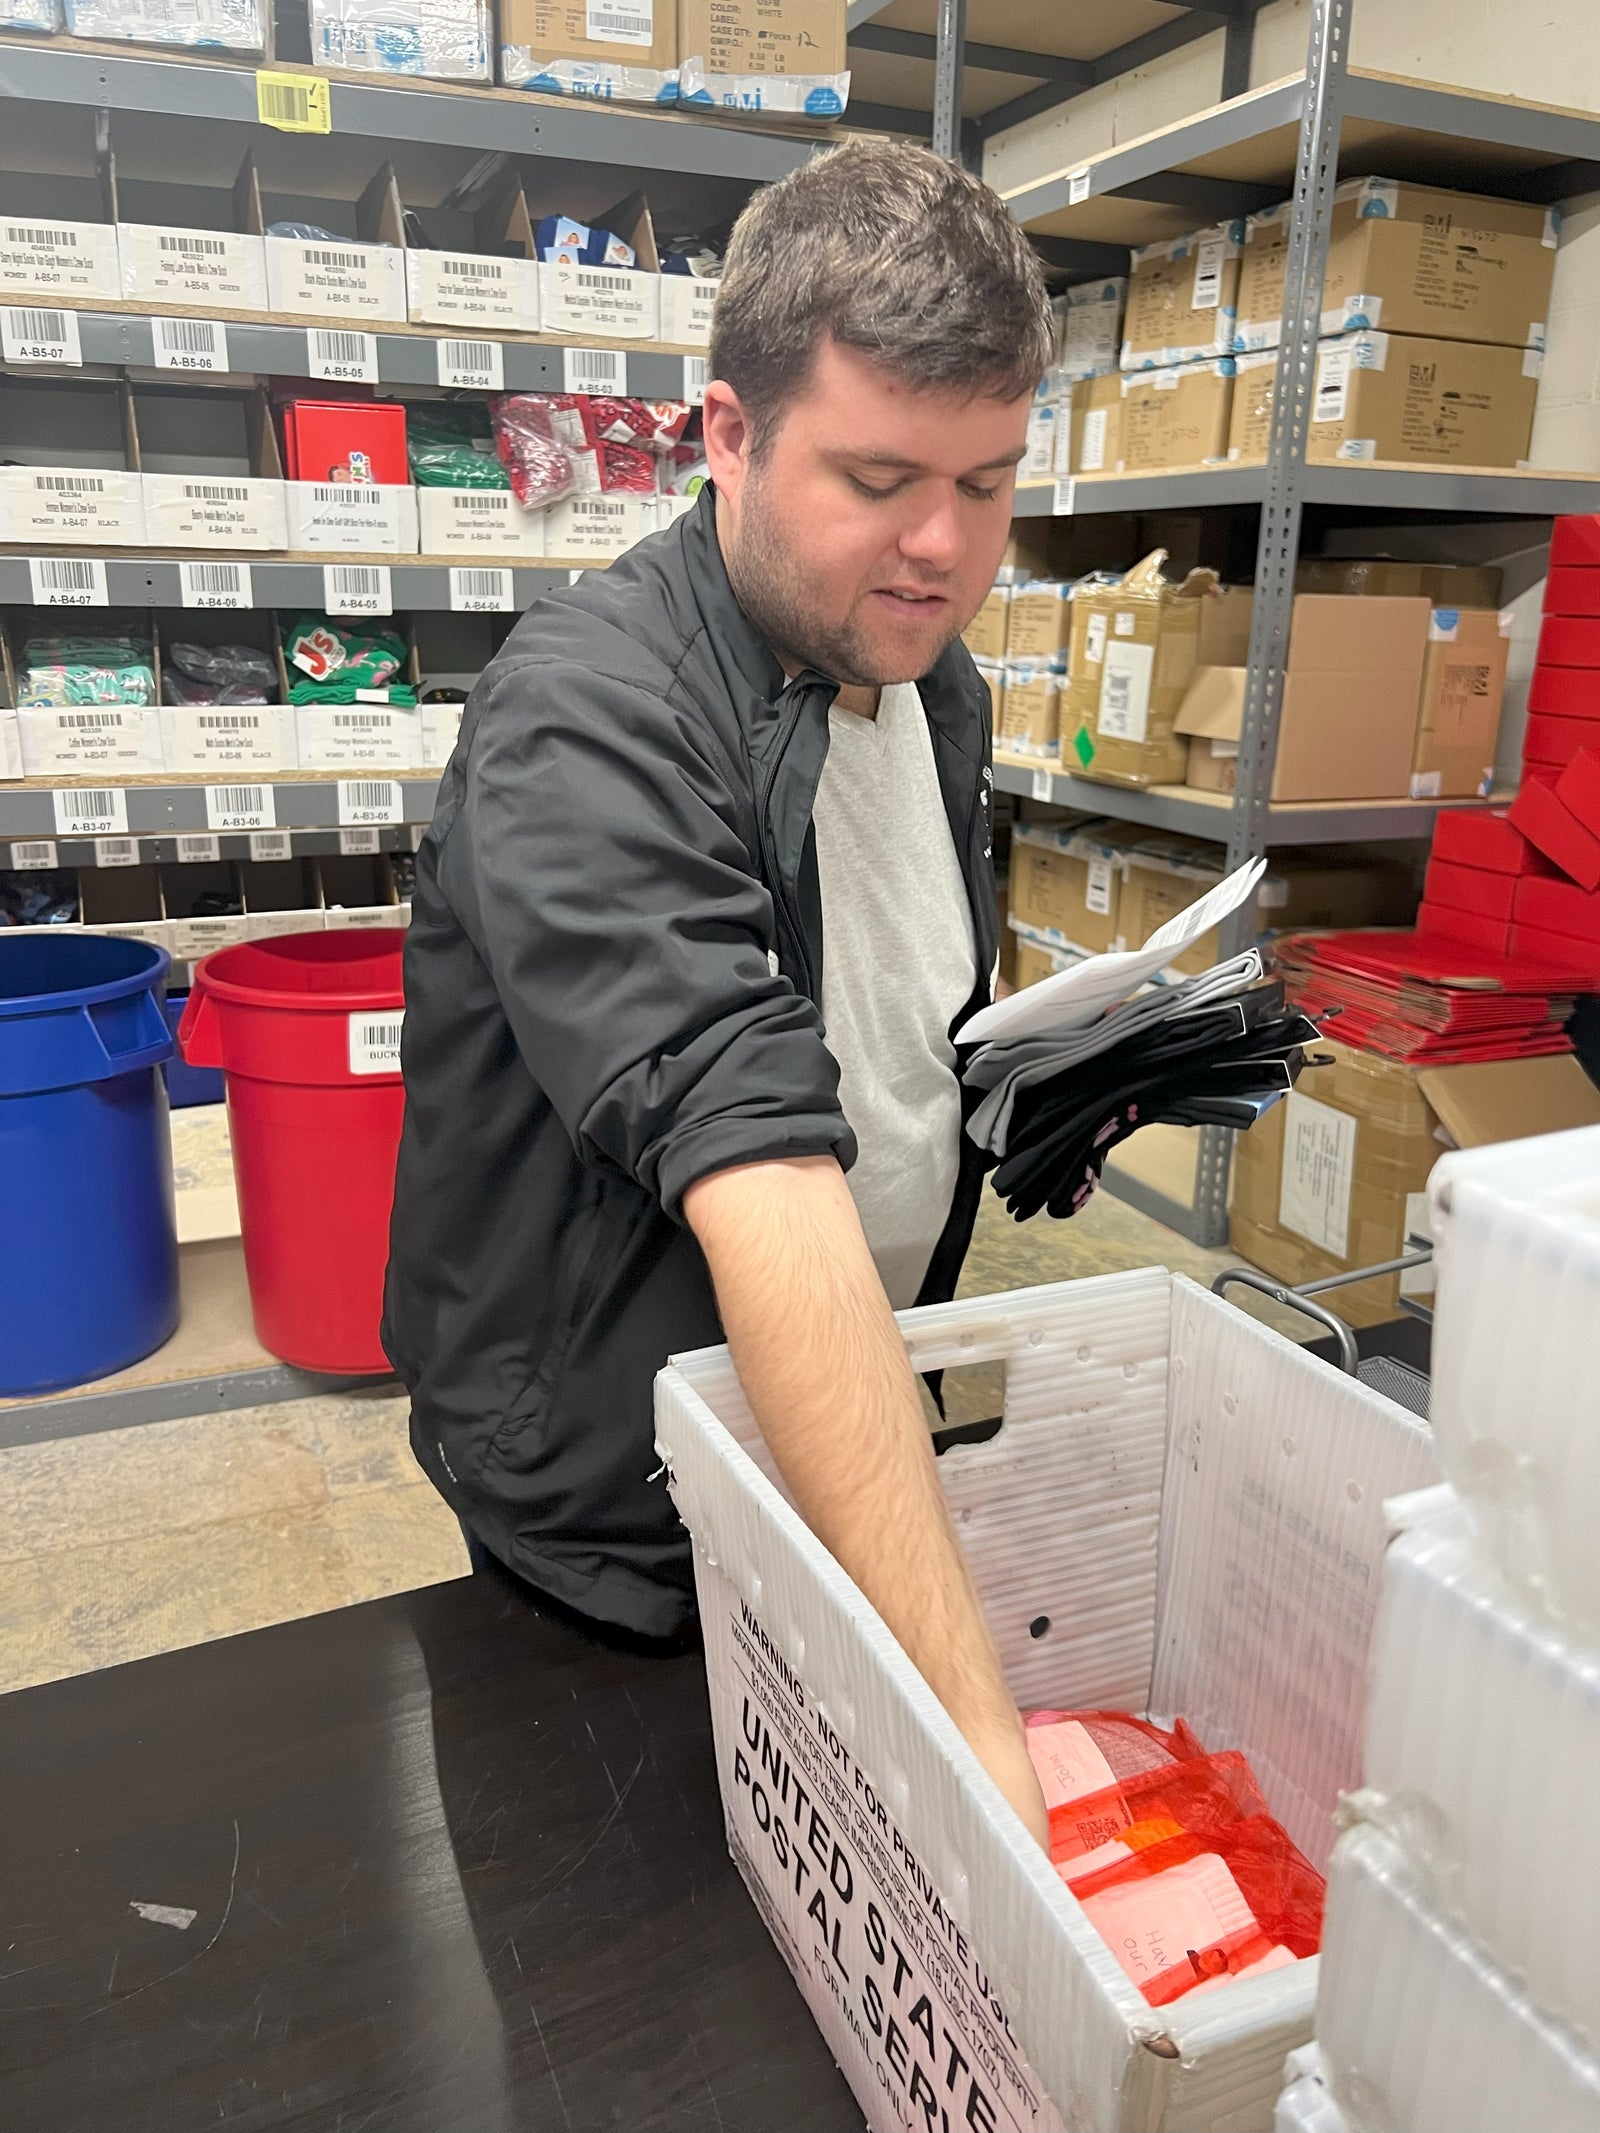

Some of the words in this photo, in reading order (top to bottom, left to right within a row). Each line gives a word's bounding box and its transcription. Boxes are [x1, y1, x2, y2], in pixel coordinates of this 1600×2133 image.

[757, 9, 783, 18] WHITE
[710, 14, 739, 25] LABEL:
[710, 25, 732, 35] CASE
[20, 347, 63, 359] A-B5-07
[170, 357, 212, 369] A-B5-06
[323, 366, 364, 378] A-B5-05
[452, 375, 490, 386] A-B5-04
[577, 383, 613, 394] A-B5-03
[50, 595, 91, 606] A-B4-07
[197, 598, 237, 608] A-B4-06
[339, 599, 378, 609] A-B4-05
[464, 602, 500, 611] A-B4-04
[352, 811, 390, 821] A-B3-05
[71, 822, 112, 832] A-B3-07
[222, 817, 261, 827] A-B3-06
[740, 1597, 805, 1708] WARNING
[817, 1711, 850, 1773] NOT
[855, 1765, 889, 1839] FOR
[893, 1826, 968, 1969] PRIVATE
[742, 1696, 854, 1905] UNITED
[775, 1709, 794, 1745] FINE
[793, 1738, 811, 1773] AND
[819, 1778, 850, 1832] YEARS
[850, 1825, 925, 1957] IMPRISONMENT
[731, 1620, 767, 1683] MAXIMUM
[767, 1672, 803, 1734] PENALTY
[804, 1731, 824, 1766] FOR
[824, 1761, 851, 1814] THEFT
[854, 1809, 874, 1842] OR
[871, 1837, 908, 1901] MISUSE
[908, 1899, 924, 1927] OF
[926, 1926, 969, 2009] POSTAL
[970, 1998, 1038, 2120] PROPERTY
[734, 1745, 850, 1984] POSTAL
[814, 1944, 840, 2004] FOR
[843, 1996, 873, 2065] MAIL
